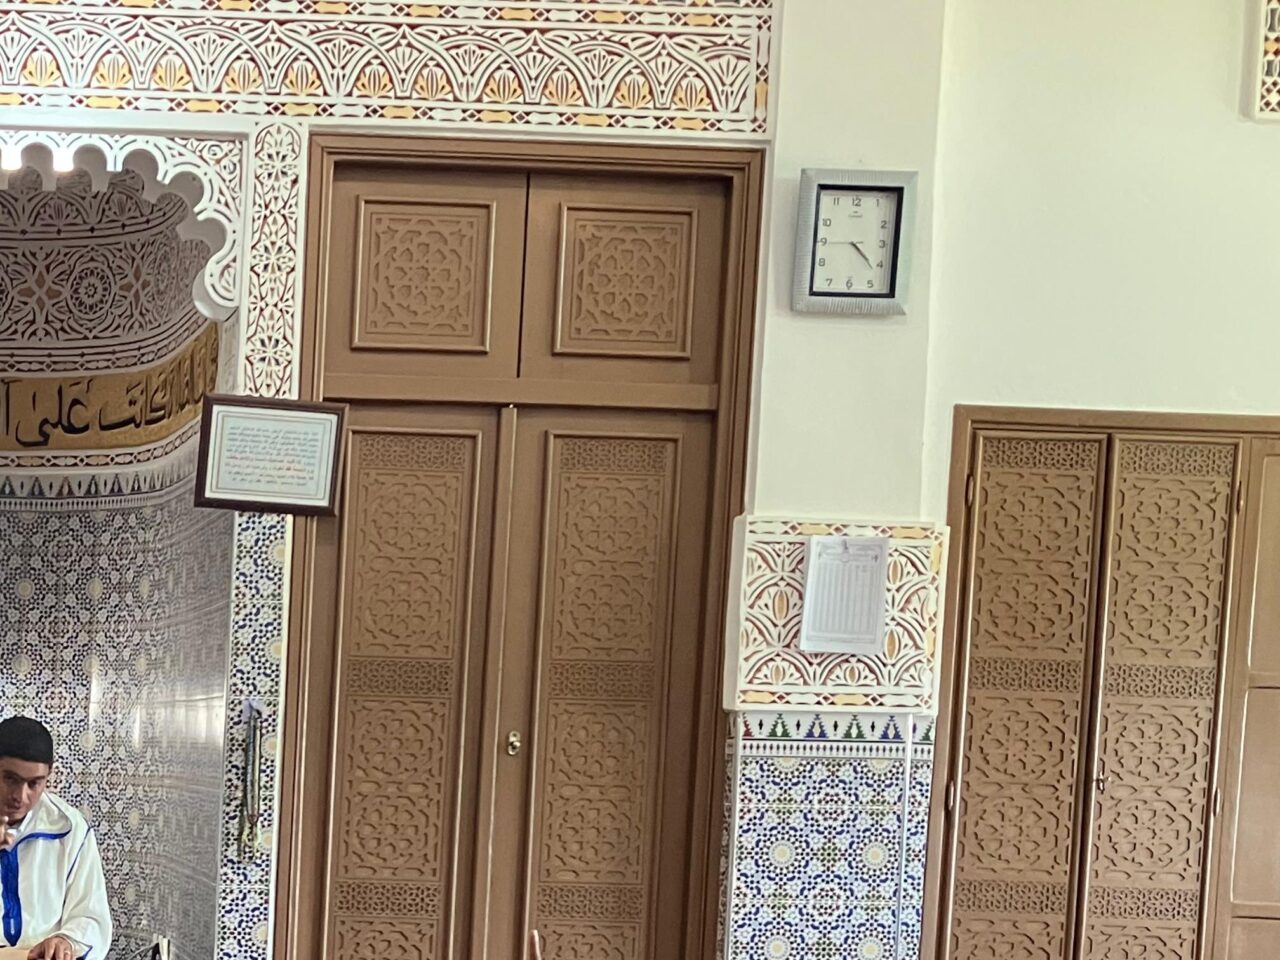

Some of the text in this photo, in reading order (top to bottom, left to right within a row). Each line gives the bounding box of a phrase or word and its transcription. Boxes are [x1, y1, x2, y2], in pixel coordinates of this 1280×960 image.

[833, 197, 840, 206] 11
[852, 197, 862, 207] 12
[822, 218, 832, 227] 10
[881, 220, 888, 229] 2
[819, 237, 828, 246] 9
[879, 240, 886, 249] 3
[818, 258, 826, 267] 8
[876, 260, 884, 269] 4
[825, 278, 833, 287] 7
[846, 279, 853, 289] 6
[867, 280, 874, 288] 5
